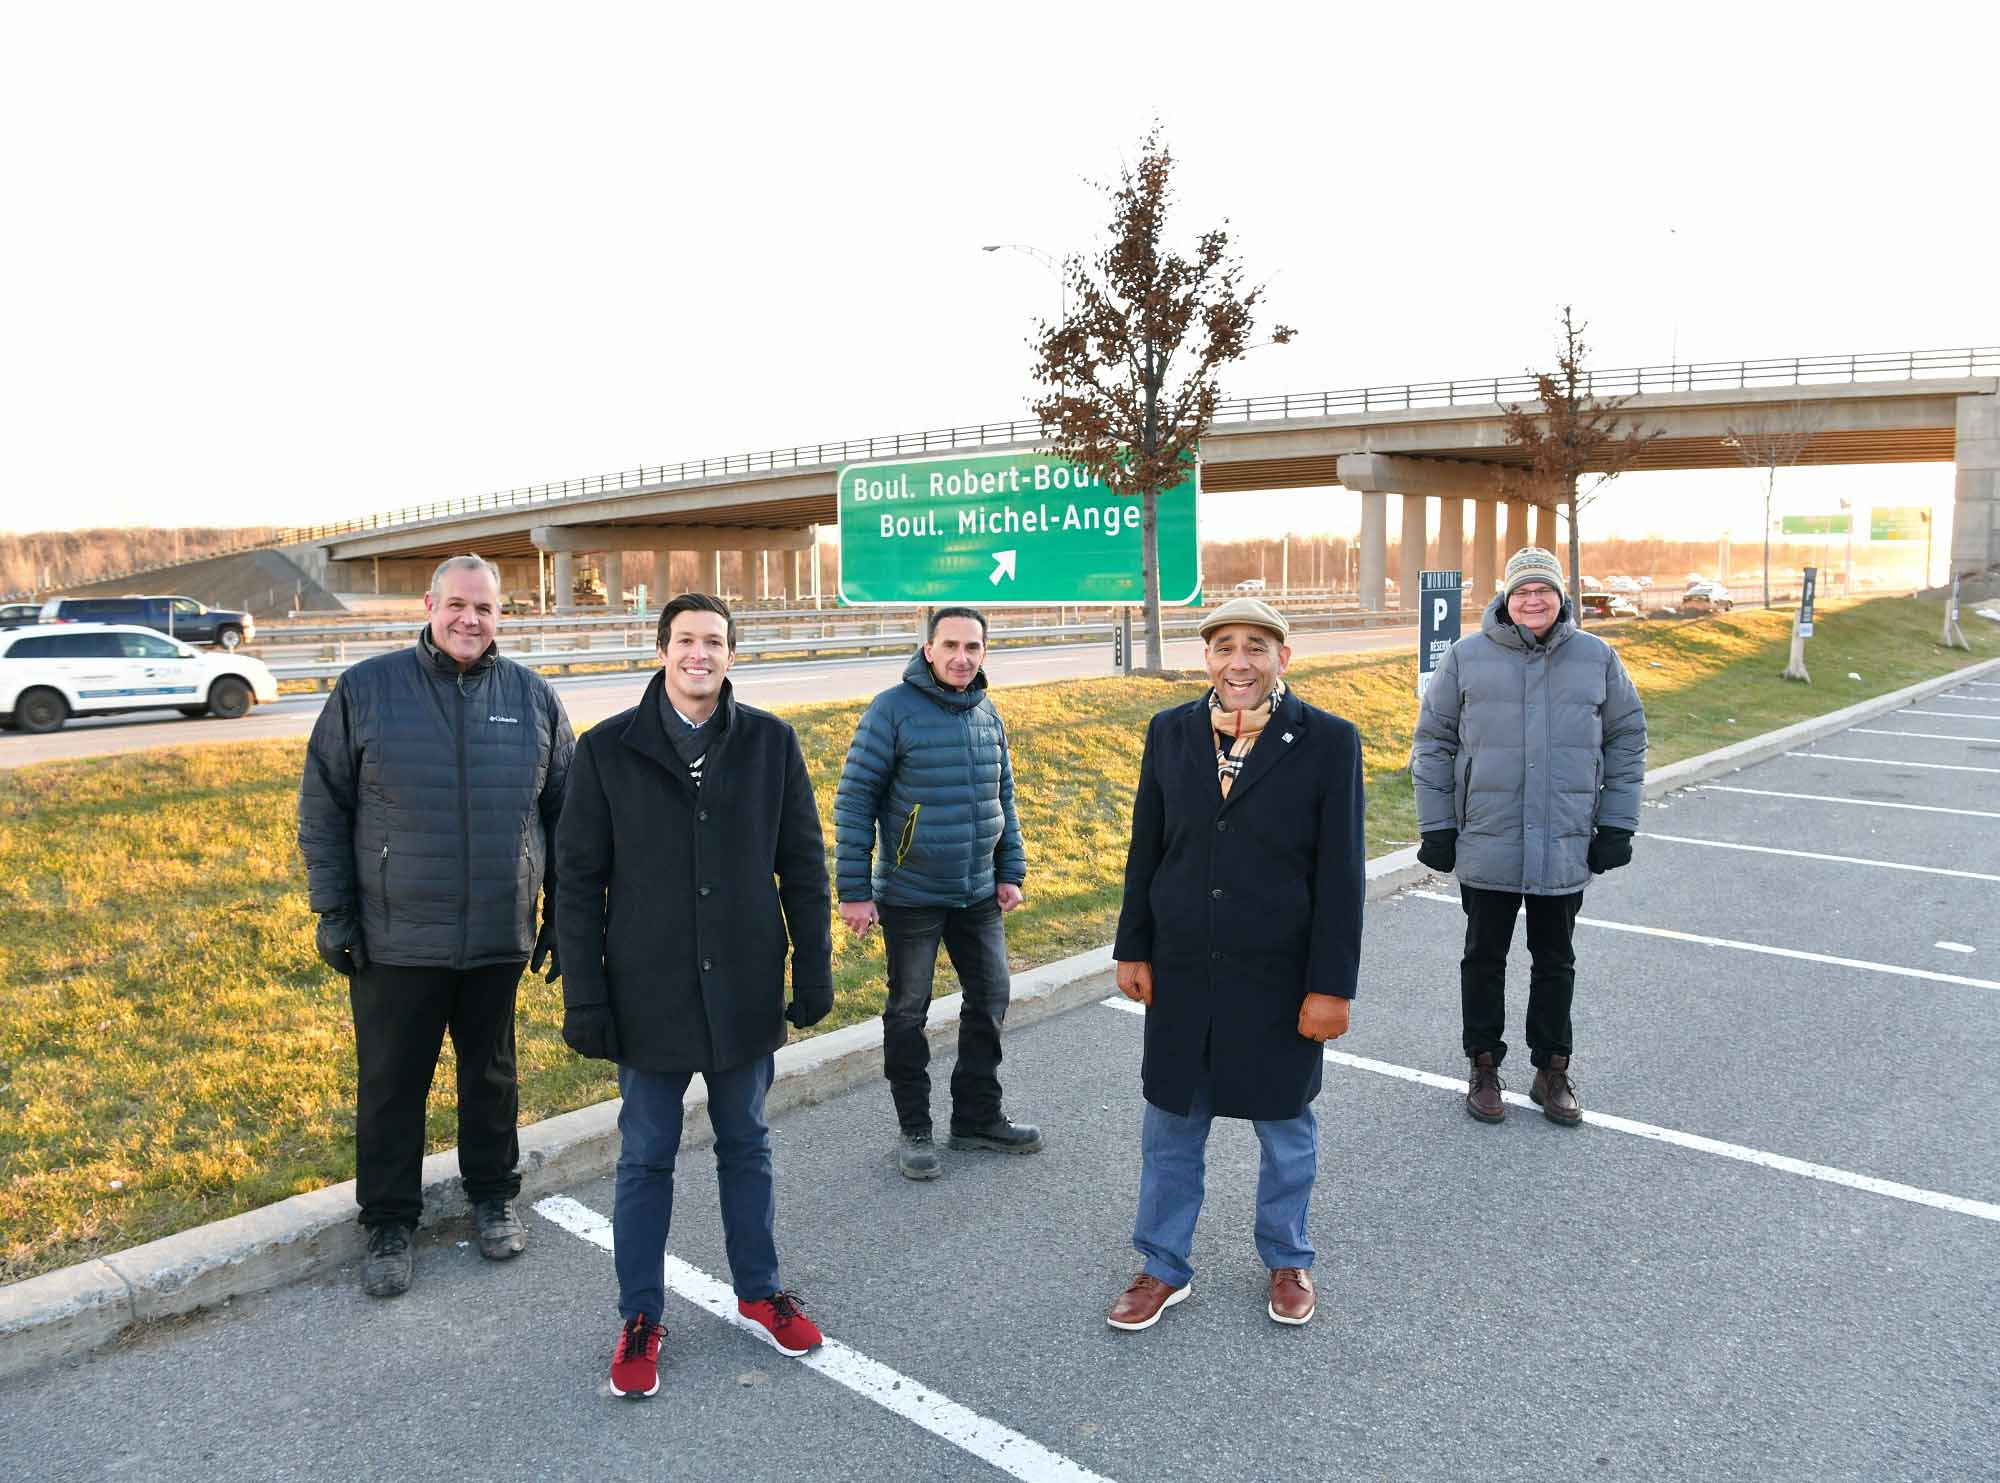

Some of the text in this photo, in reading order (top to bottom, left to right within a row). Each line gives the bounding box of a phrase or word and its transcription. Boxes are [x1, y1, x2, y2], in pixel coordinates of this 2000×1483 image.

[853, 473, 917, 502] Boul.
[880, 503, 1141, 538] Boul. Michel-Ange
[1434, 598, 1448, 631] P
